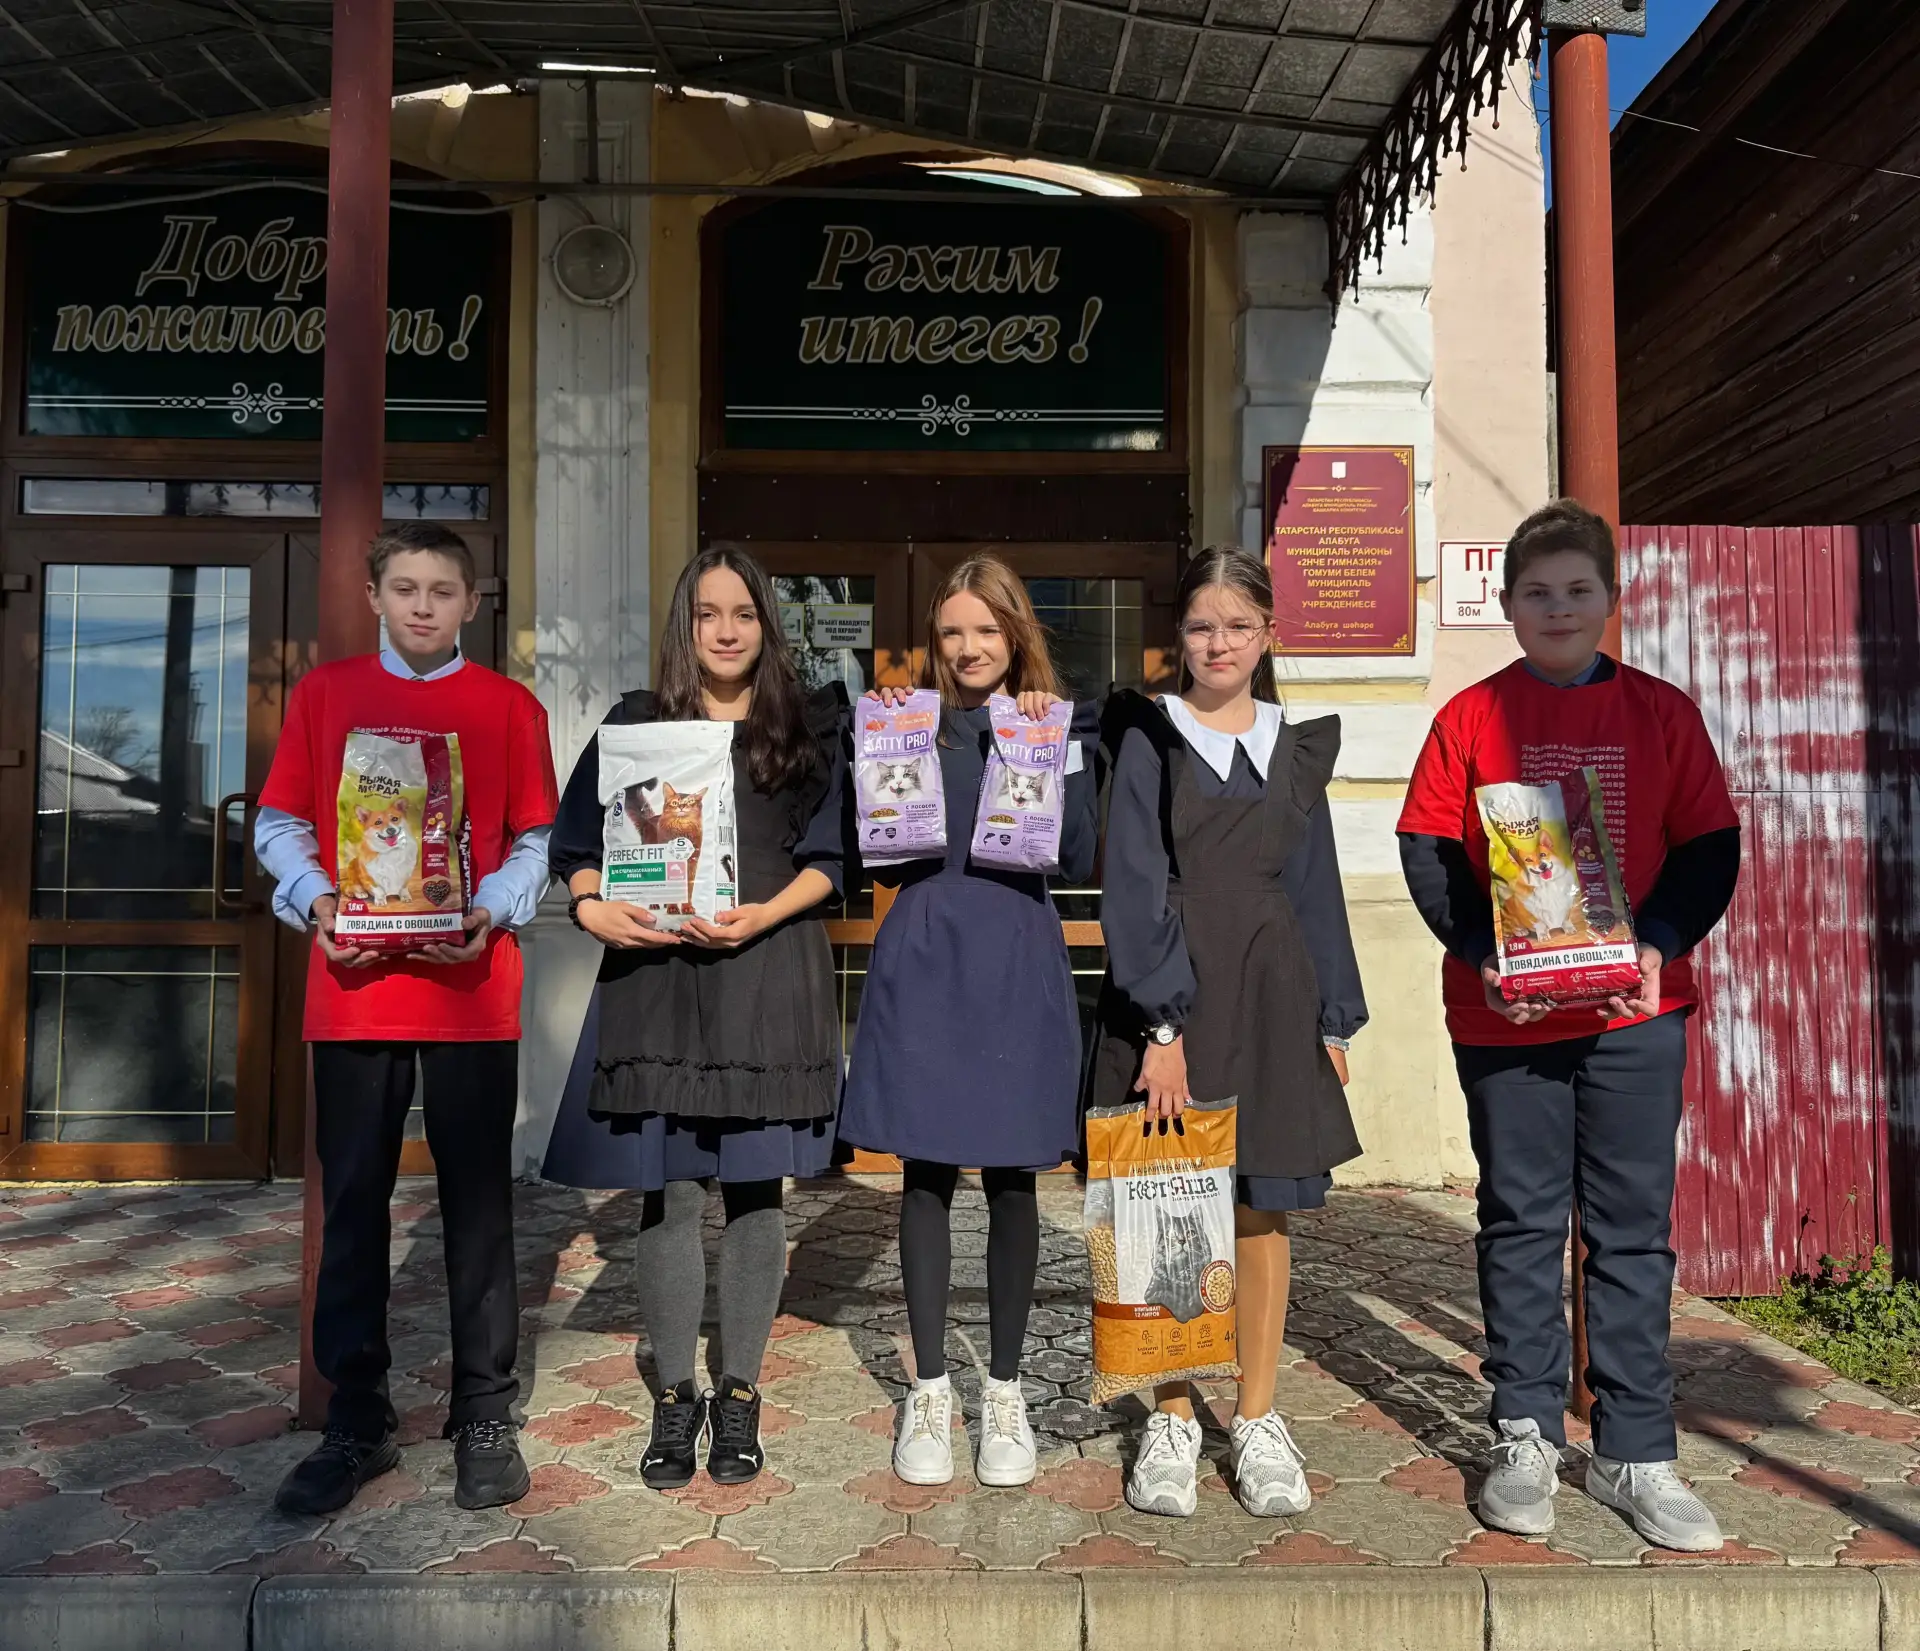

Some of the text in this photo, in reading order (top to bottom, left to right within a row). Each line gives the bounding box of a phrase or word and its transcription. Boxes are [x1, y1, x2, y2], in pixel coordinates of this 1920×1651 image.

[136, 215, 329, 300] Добр
[807, 225, 1061, 293] Рәхим
[1275, 526, 1404, 535] ТАТАРСТАН РЕСПУБЛИКАСЫ
[1318, 537, 1360, 545] АЛАБУГА
[1286, 546, 1392, 557] МУНИЦИПАЛЬ РАЙОНЫ
[1297, 558, 1382, 566] «2НЧЕ ГИМНАЗИЯ»
[1303, 568, 1376, 577] ГОМУМИ БЕЛЕМ
[1307, 579, 1372, 588] МУНИЦИПАЛЬ
[1318, 589, 1360, 599] БЮДЖЕТ
[1301, 600, 1377, 609] УЧРЕЖДЕНИЕСЕ
[1304, 621, 1339, 630] Алабуга
[906, 731, 927, 749] PRO
[1034, 745, 1054, 762] PRO
[360, 775, 402, 788] РЫЖАЯ
[676, 838, 686, 847] 5
[608, 847, 665, 862] PERFECT FIT
[347, 918, 453, 931] ГОВЯДИНА С ОВОЩАМИ
[1510, 956, 1561, 971] ГОВЯДИНА
[1563, 954, 1571, 965] С
